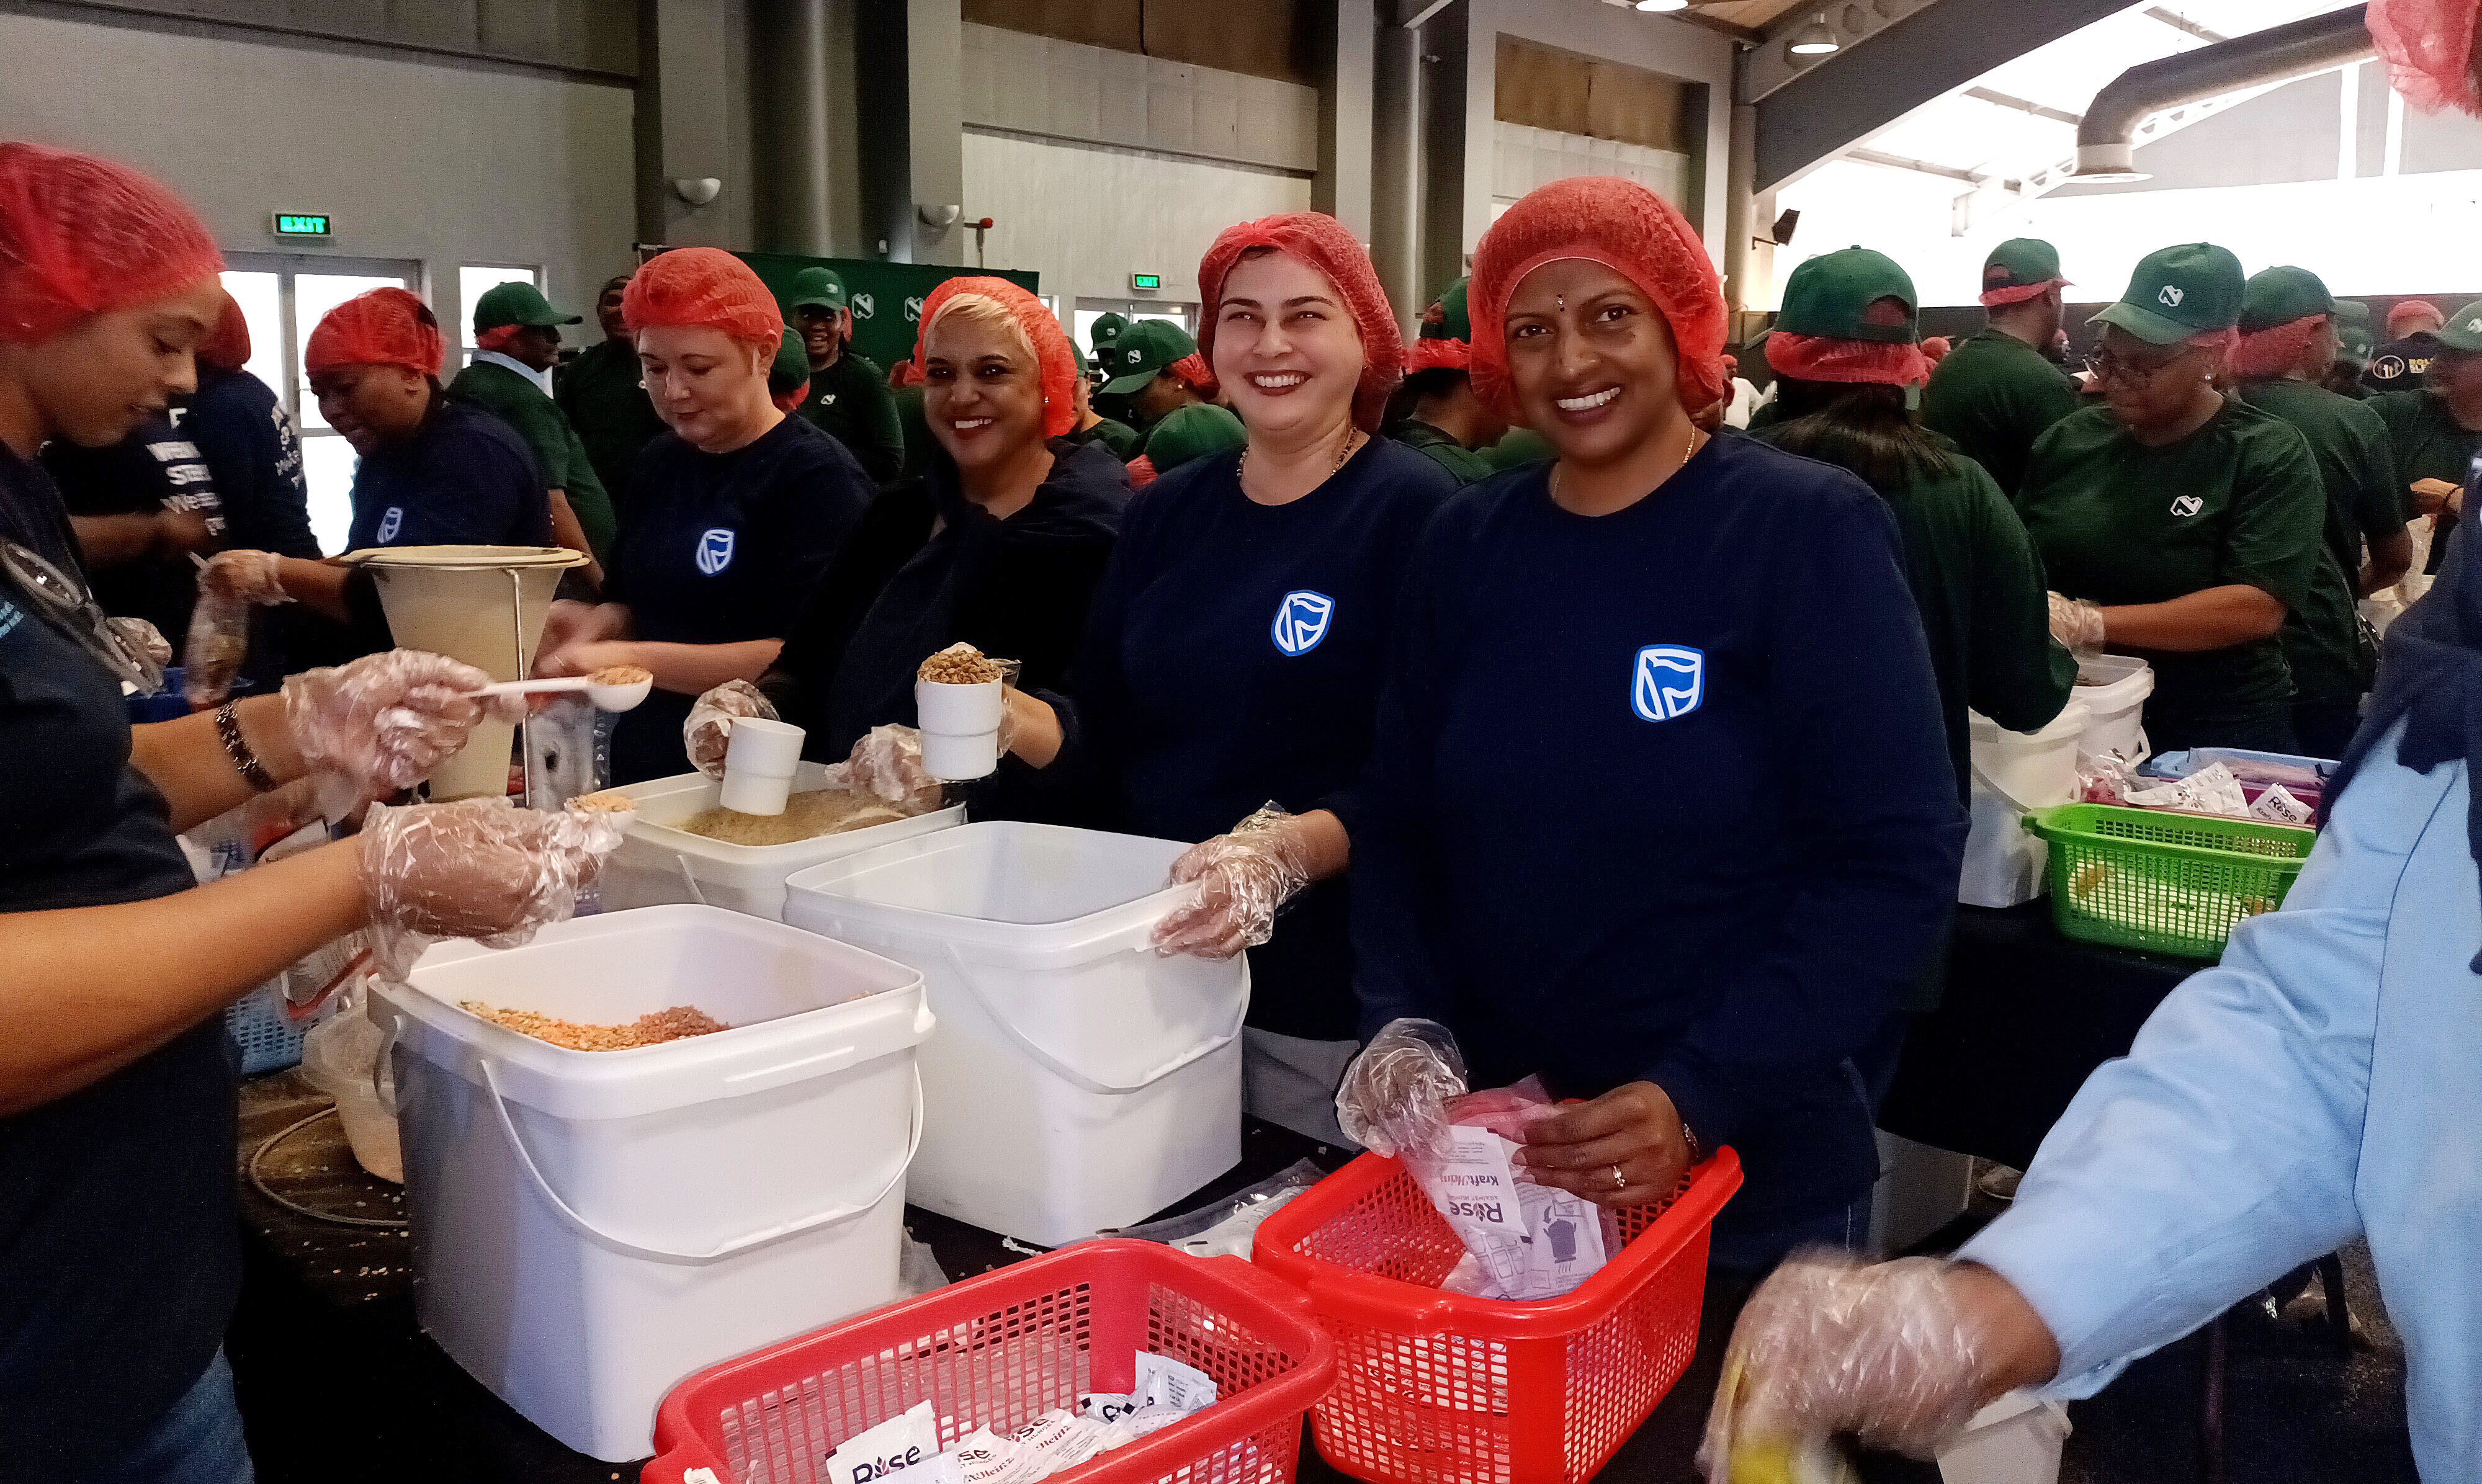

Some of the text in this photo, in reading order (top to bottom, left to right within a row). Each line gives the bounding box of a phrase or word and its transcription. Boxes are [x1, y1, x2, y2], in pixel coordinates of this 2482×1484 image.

[280, 217, 325, 233] EXIT
[1136, 276, 1158, 287] EXIT
[1449, 1201, 1503, 1223] Rise
